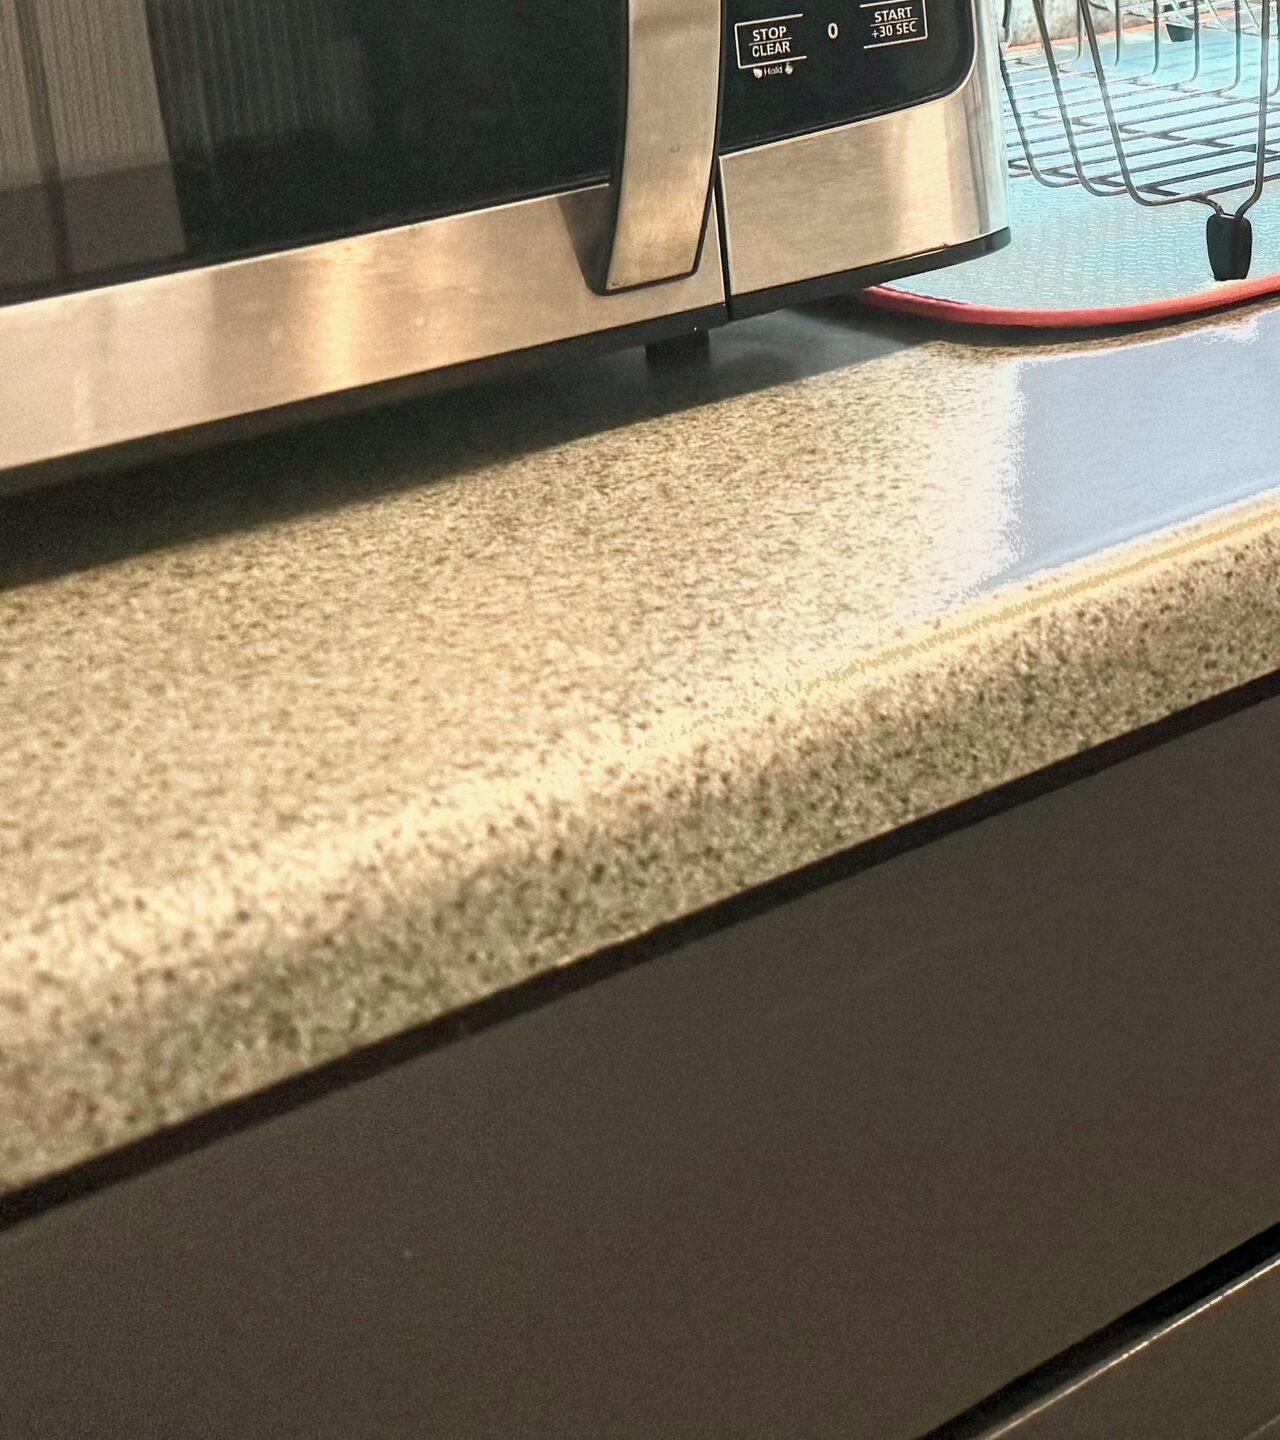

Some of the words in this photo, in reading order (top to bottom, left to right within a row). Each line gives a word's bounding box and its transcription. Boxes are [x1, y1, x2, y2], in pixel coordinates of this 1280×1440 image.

[875, 7, 912, 23] START
[753, 26, 788, 42] STOP
[828, 23, 838, 38] 0
[871, 24, 892, 38] +30
[896, 21, 916, 34] SEC
[752, 41, 790, 57] CLEAR
